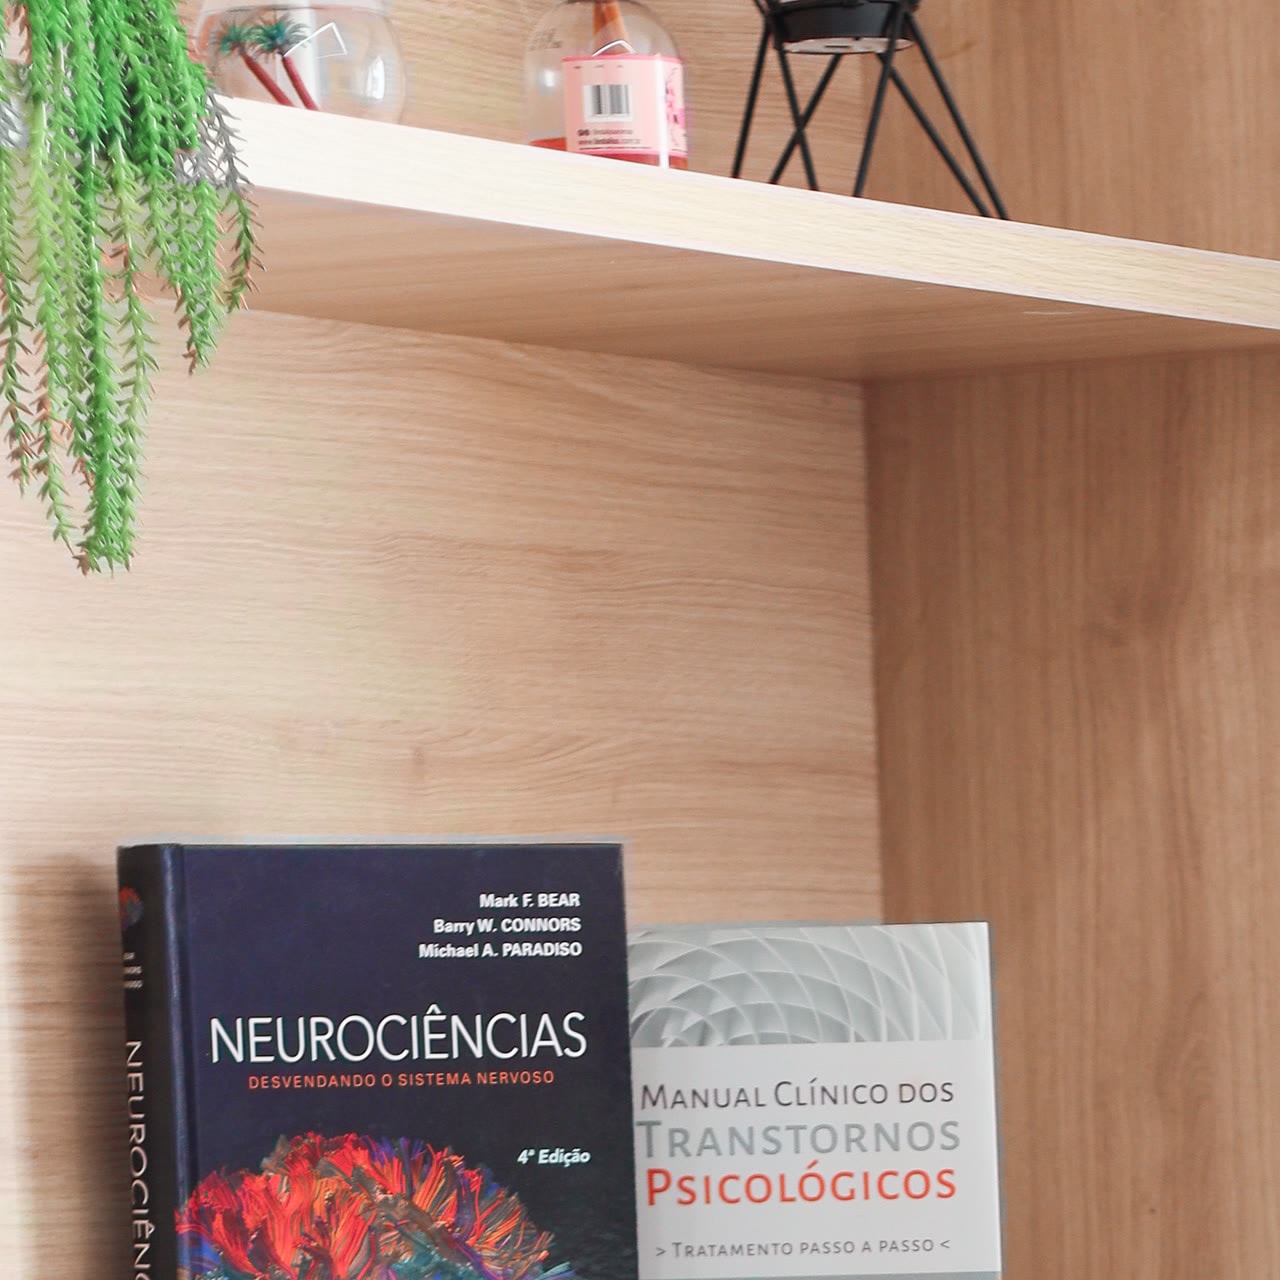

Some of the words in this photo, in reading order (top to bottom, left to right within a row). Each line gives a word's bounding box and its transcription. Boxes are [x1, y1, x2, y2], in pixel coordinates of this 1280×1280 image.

[479, 892, 519, 908] Mark
[522, 892, 534, 907] F.
[538, 891, 580, 908] BEAR
[434, 918, 475, 937] Barry
[477, 918, 497, 933] W.
[501, 917, 581, 933] CONNORS
[419, 943, 479, 959] Michael
[482, 943, 498, 958] A.
[502, 942, 582, 958] PARADISO
[210, 1004, 587, 1065] NEUROCIÊNCIAS
[248, 1073, 376, 1090] DESVENDANDO
[381, 1073, 393, 1088] O
[398, 1071, 472, 1087] SISTEMA
[476, 1070, 554, 1086] NERVOSO
[641, 1083, 767, 1111] MANUAL
[774, 1077, 888, 1107] CLÍNICO
[898, 1080, 954, 1104] DOS
[636, 1119, 961, 1159] TRANSTORNOS
[538, 1148, 591, 1169] Edição
[647, 1160, 957, 1207] PSICOLÓGICOS
[800, 1240, 856, 1256] PASSO
[878, 1238, 934, 1254] PASSO
